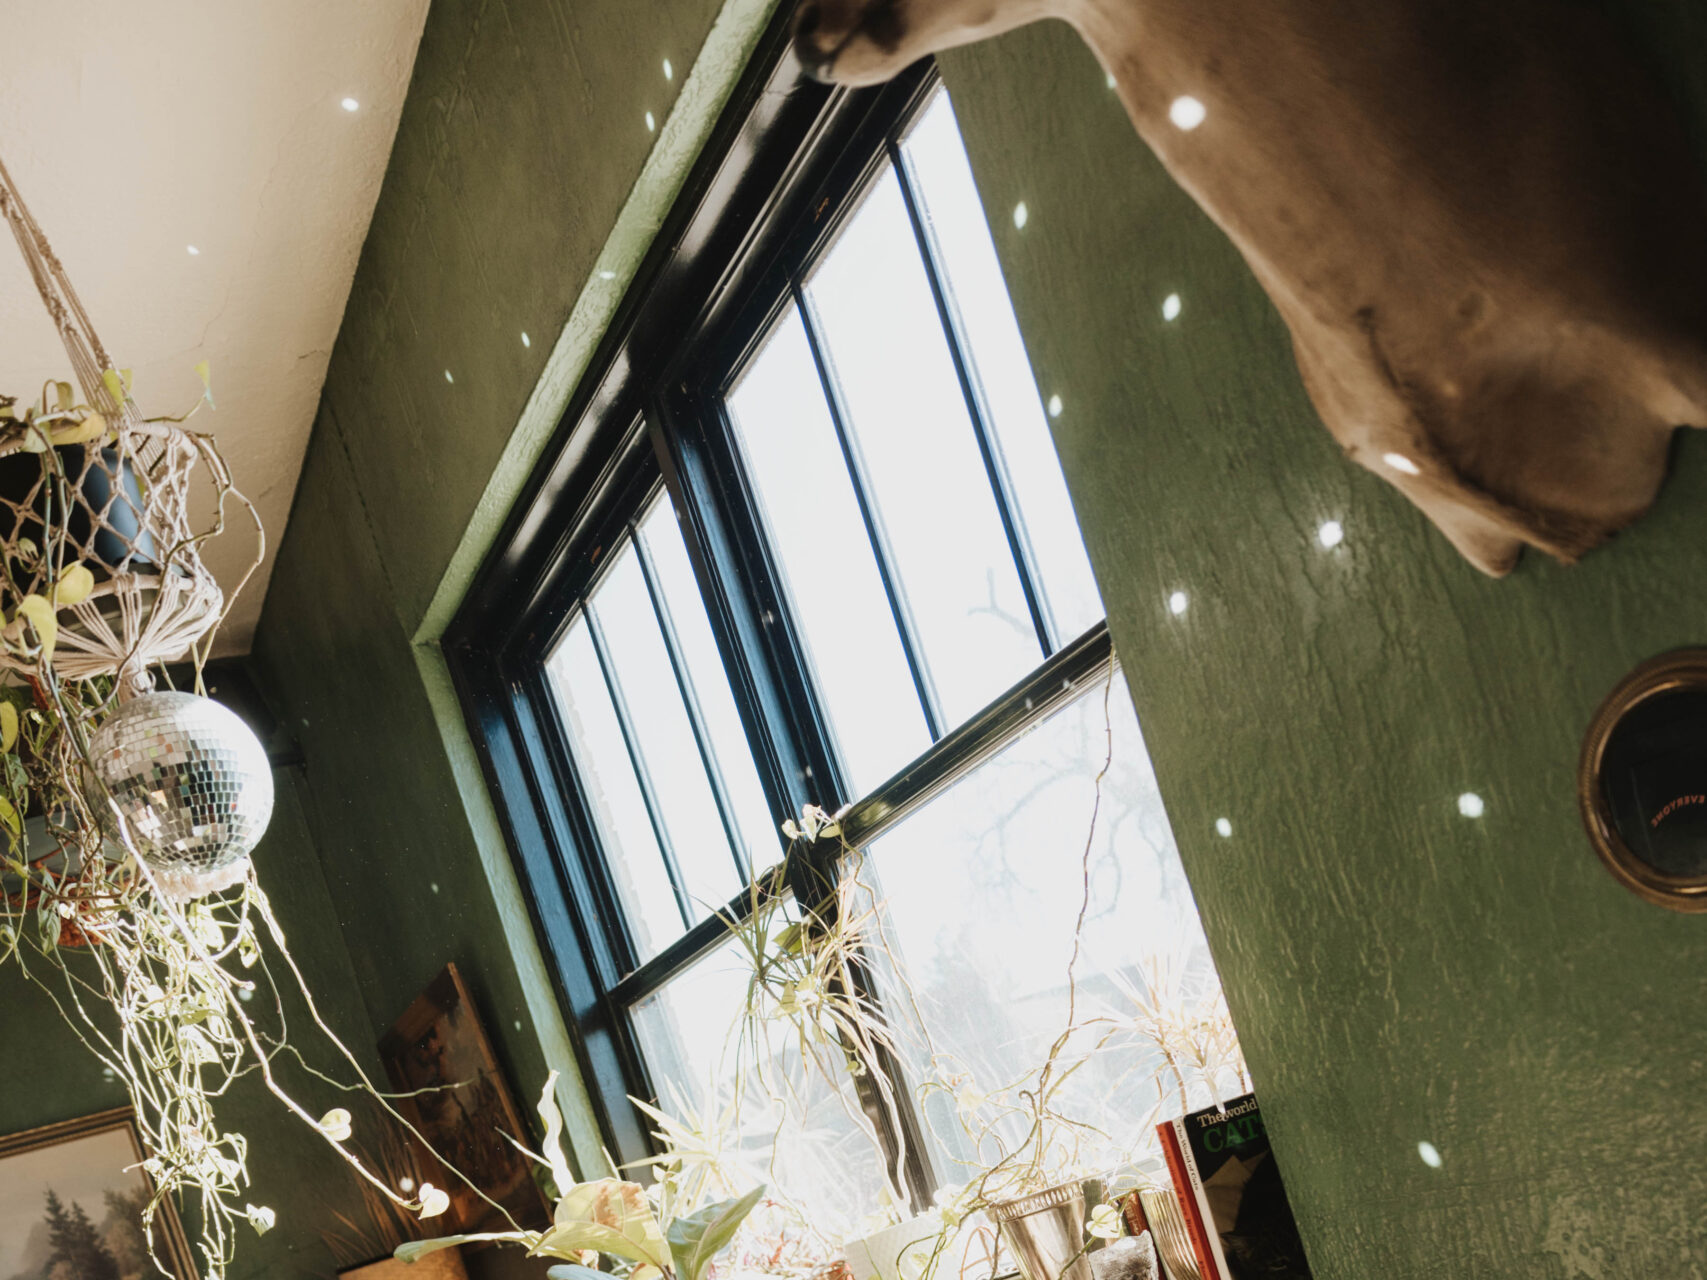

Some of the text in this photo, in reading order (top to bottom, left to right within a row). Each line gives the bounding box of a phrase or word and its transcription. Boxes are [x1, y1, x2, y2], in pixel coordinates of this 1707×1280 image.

[1197, 1098, 1258, 1128] The world
[1203, 1112, 1269, 1153] CAT
[1181, 1139, 1191, 1163] World
